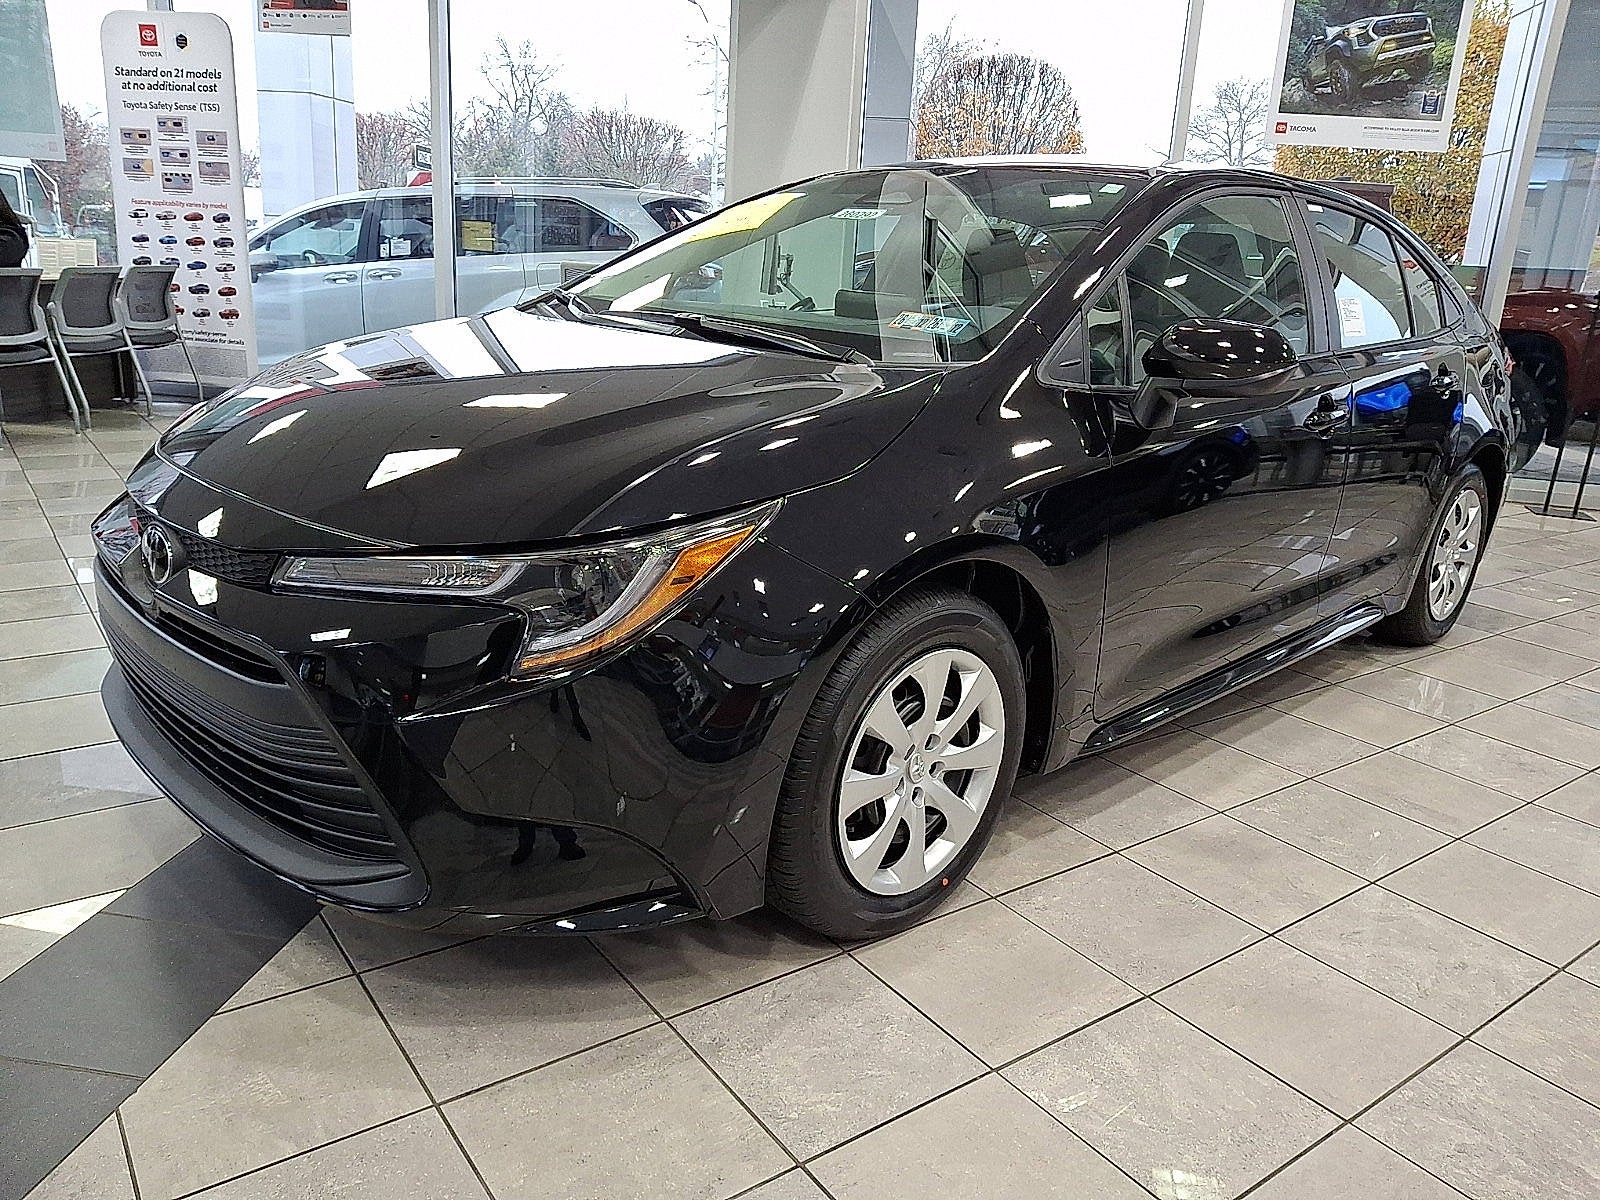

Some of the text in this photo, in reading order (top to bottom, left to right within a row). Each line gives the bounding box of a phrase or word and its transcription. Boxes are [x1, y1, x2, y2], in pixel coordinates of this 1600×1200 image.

[138, 50, 163, 58] TOYOTA
[114, 67, 222, 80] Standard on 21 models
[121, 81, 132, 90] at
[147, 81, 196, 92] additional
[197, 83, 218, 92] cost
[122, 101, 147, 111] Toyota
[148, 100, 173, 112] Safety
[199, 103, 220, 112] (TSS)
[1289, 125, 1316, 133] TACOMA
[131, 198, 151, 206] Feature
[151, 200, 185, 209] applicability
